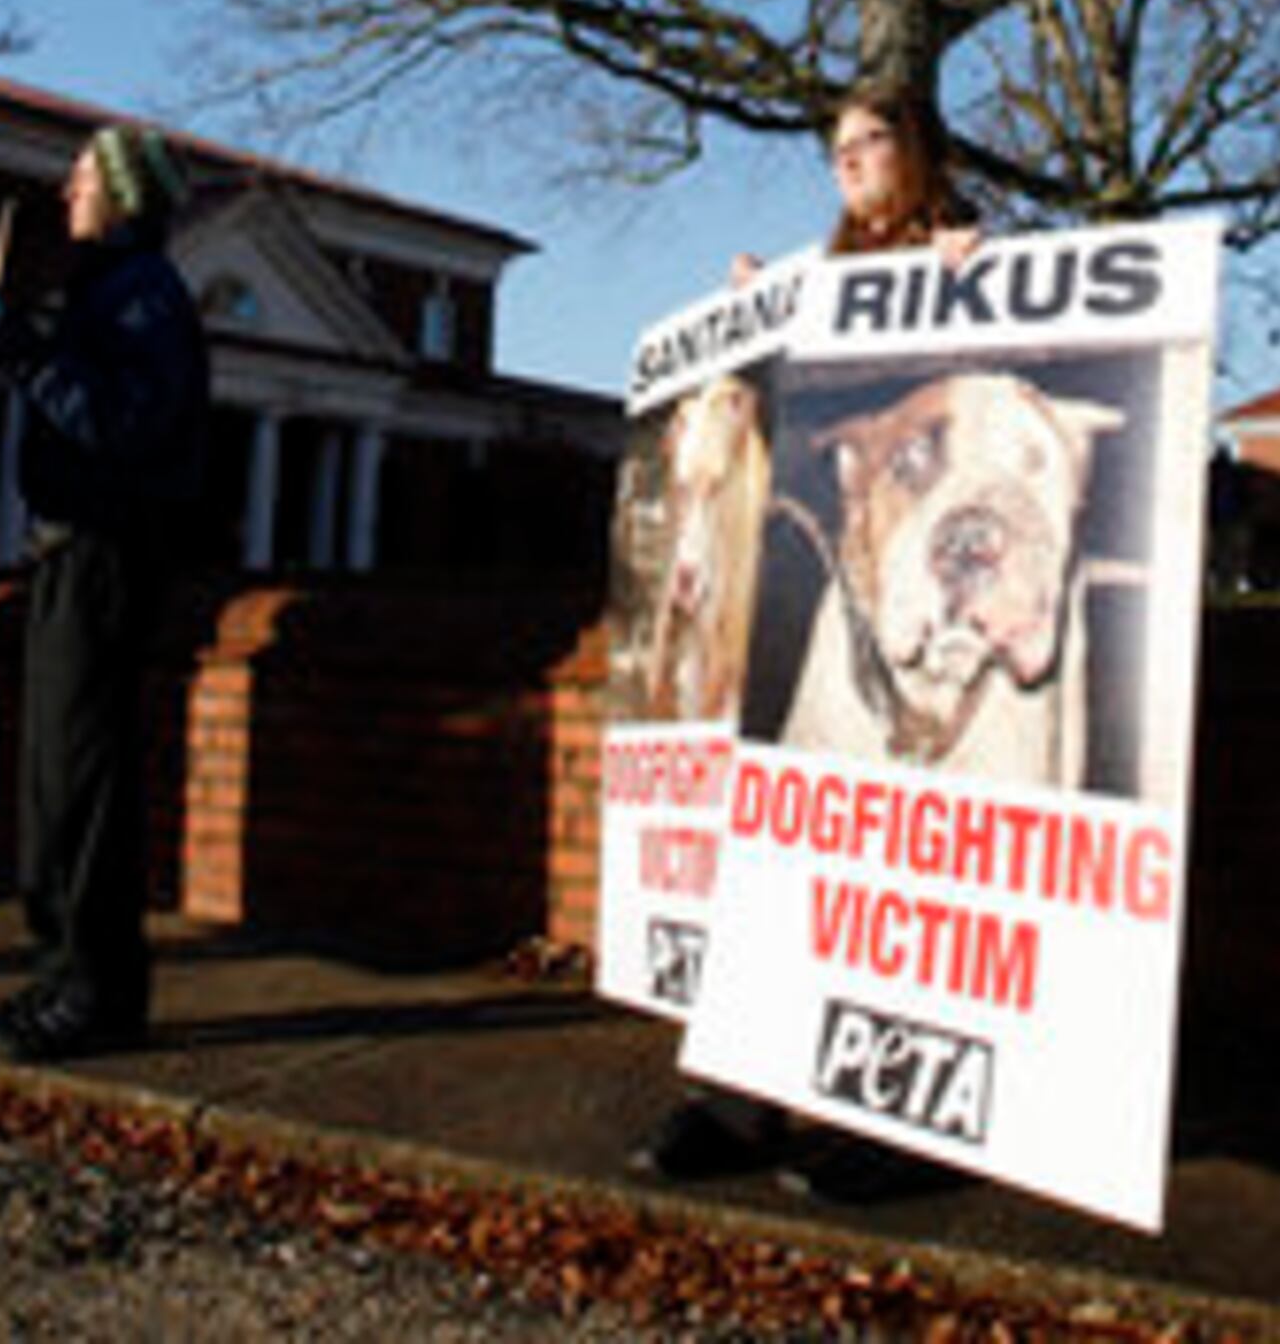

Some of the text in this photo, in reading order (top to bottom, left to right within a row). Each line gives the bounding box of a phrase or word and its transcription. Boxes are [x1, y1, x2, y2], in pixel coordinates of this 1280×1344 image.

[833, 241, 1162, 334] RIKUS
[729, 760, 1174, 921] DOGFIGHTING
[811, 875, 1042, 1014] VICTIM
